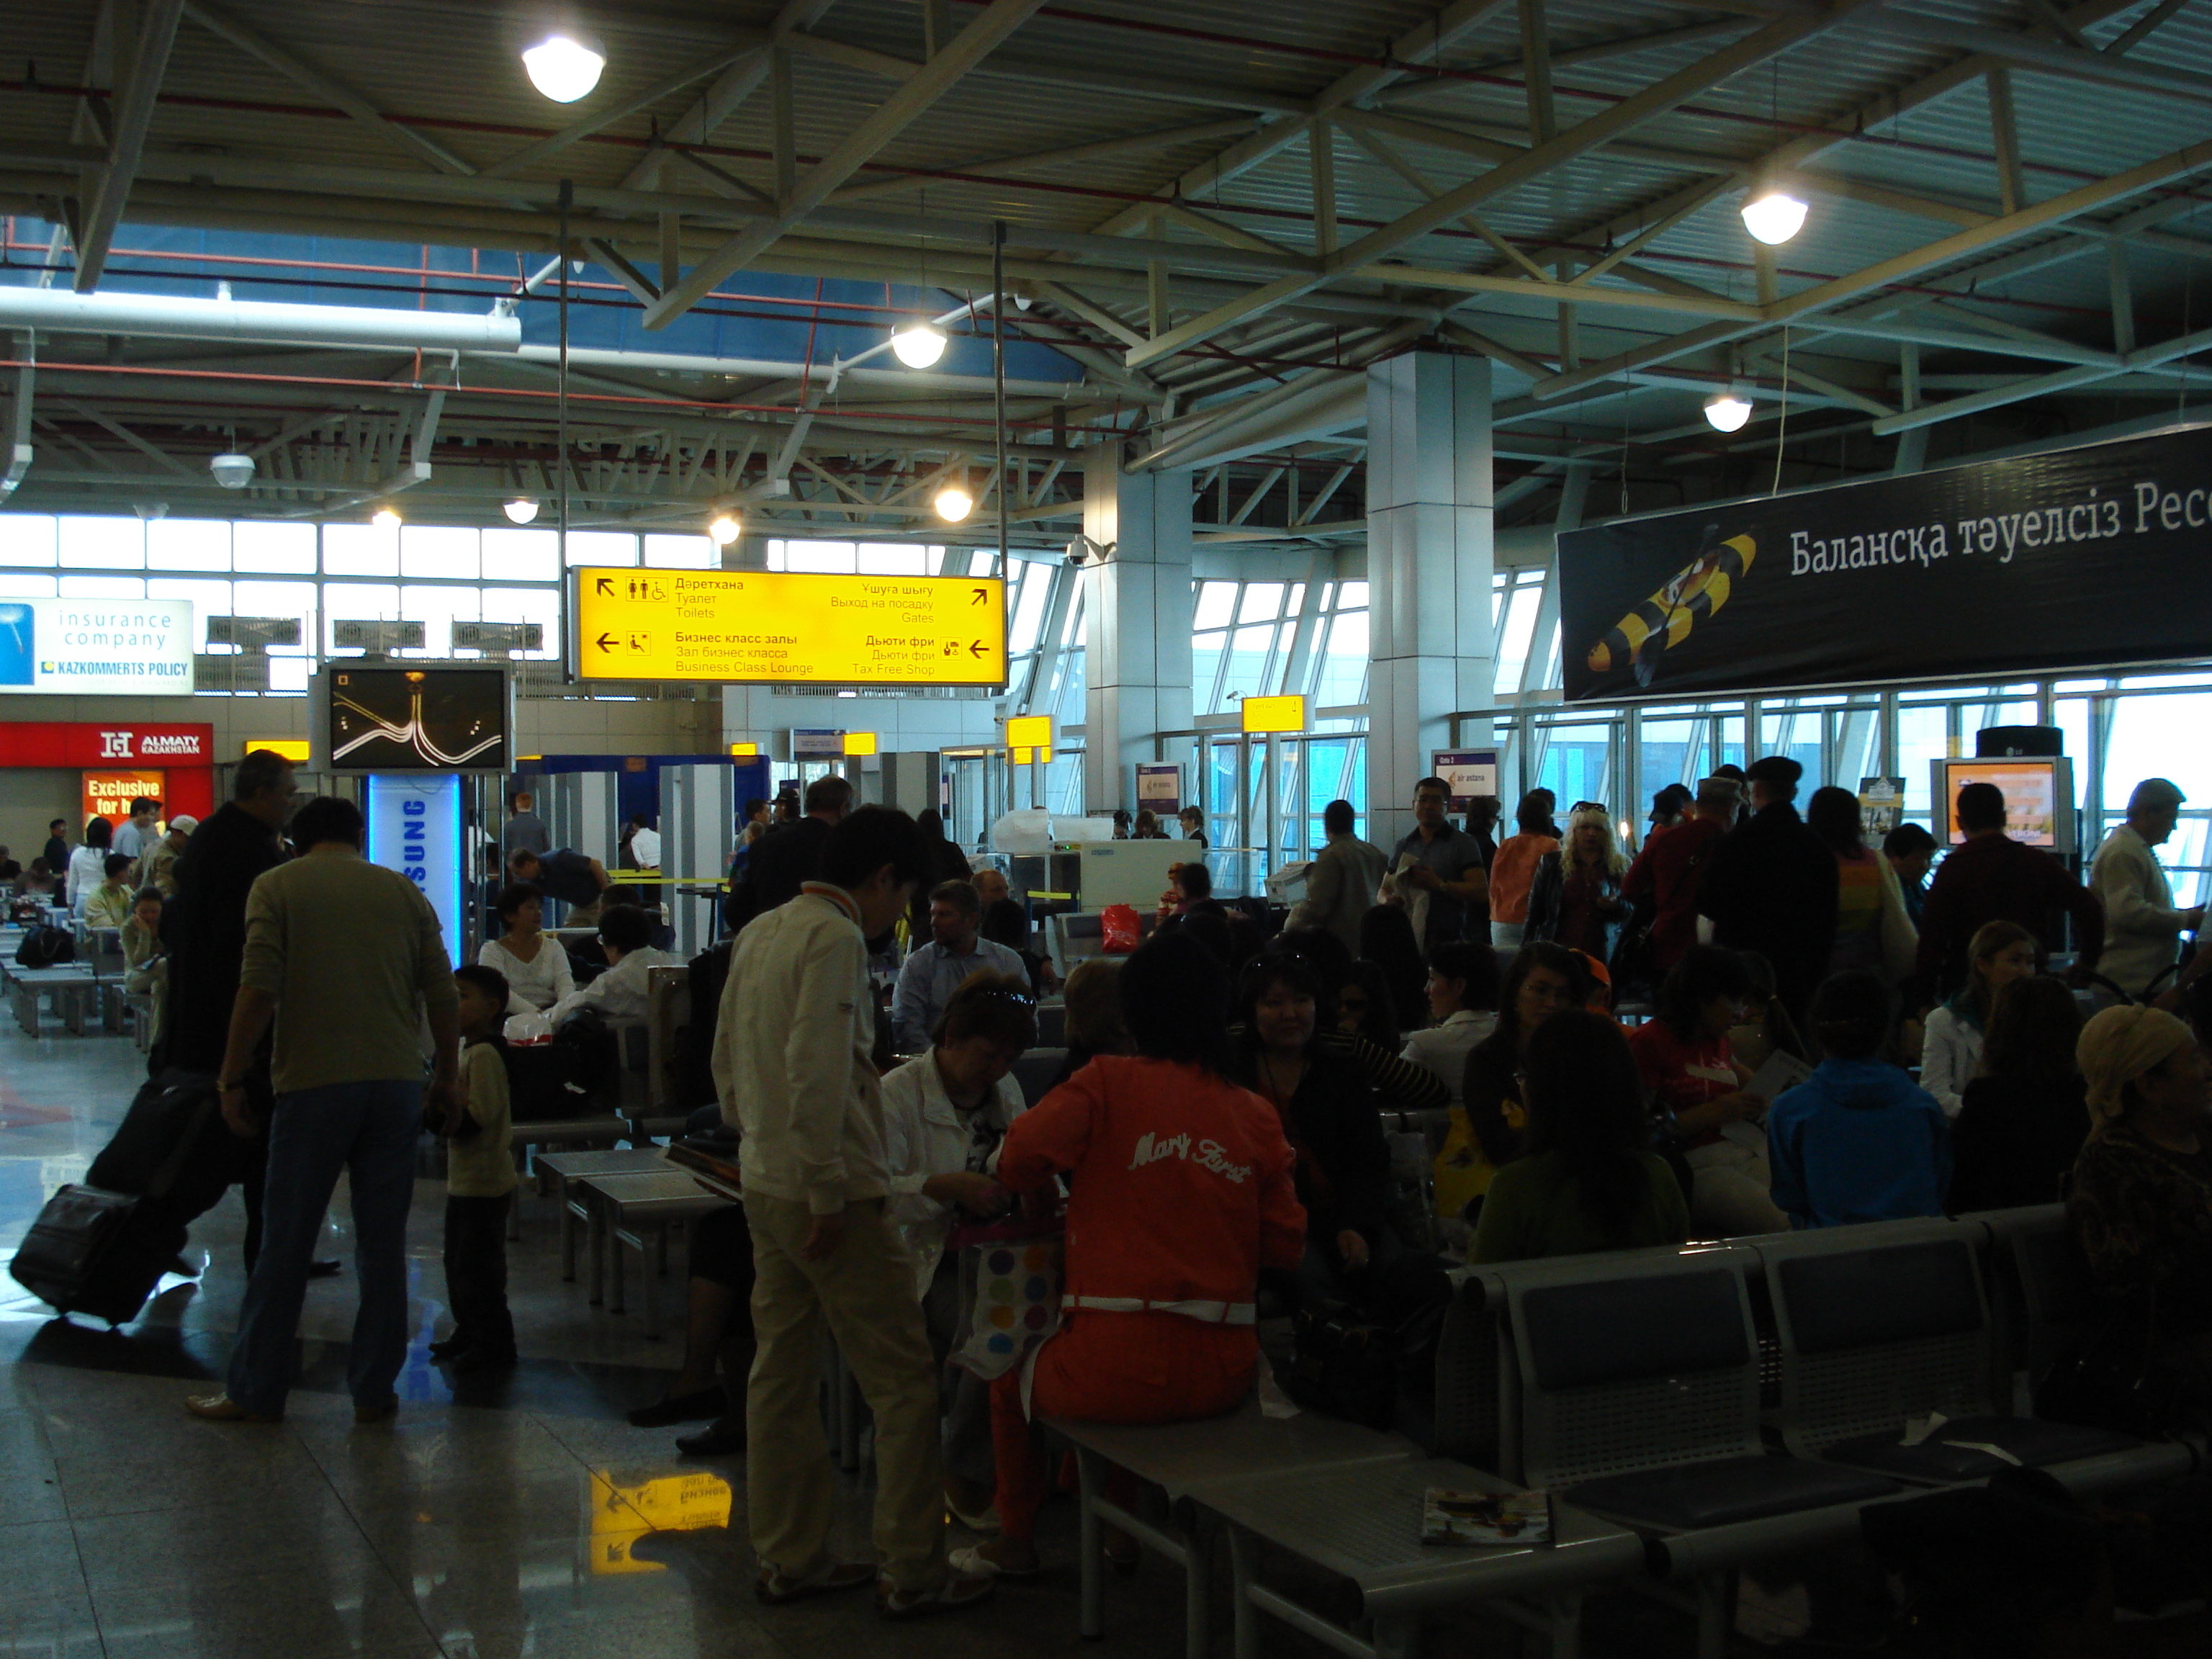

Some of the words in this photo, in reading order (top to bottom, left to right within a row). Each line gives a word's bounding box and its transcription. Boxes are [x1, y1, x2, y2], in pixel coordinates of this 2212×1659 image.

[1790, 522, 1948, 575] Балансқа
[1958, 488, 2121, 563] тәуелсіз
[675, 578, 744, 590] Дәретхана
[902, 586, 933, 597] шығу
[675, 593, 716, 606] Туалет
[831, 597, 868, 608] Выход
[889, 601, 933, 611] посадку
[60, 610, 171, 628] insurance
[675, 607, 715, 619] Toilets
[902, 612, 934, 623] Gates
[65, 633, 166, 650] company
[675, 631, 721, 642] Бизнес
[725, 634, 761, 644] класс
[765, 635, 797, 644] залы
[866, 635, 906, 647] Дьюти
[909, 637, 935, 648] фри
[675, 647, 698, 657] Зал
[703, 647, 744, 658] бизнес
[747, 649, 788, 658] класса
[872, 649, 908, 661] Дьюти
[912, 651, 935, 662] фри
[58, 662, 145, 675] KAZKOMMERTS
[148, 662, 188, 676] POLICY
[675, 661, 729, 673] Business
[734, 662, 767, 673] Class
[770, 662, 814, 675] Lounge
[853, 663, 873, 674] Tax
[877, 664, 902, 675] Free
[907, 664, 935, 677] Shop
[142, 736, 199, 746] ALMATY
[141, 745, 200, 755] KAZAKHSTAN
[89, 780, 160, 796] Exclusive
[96, 799, 118, 814] for
